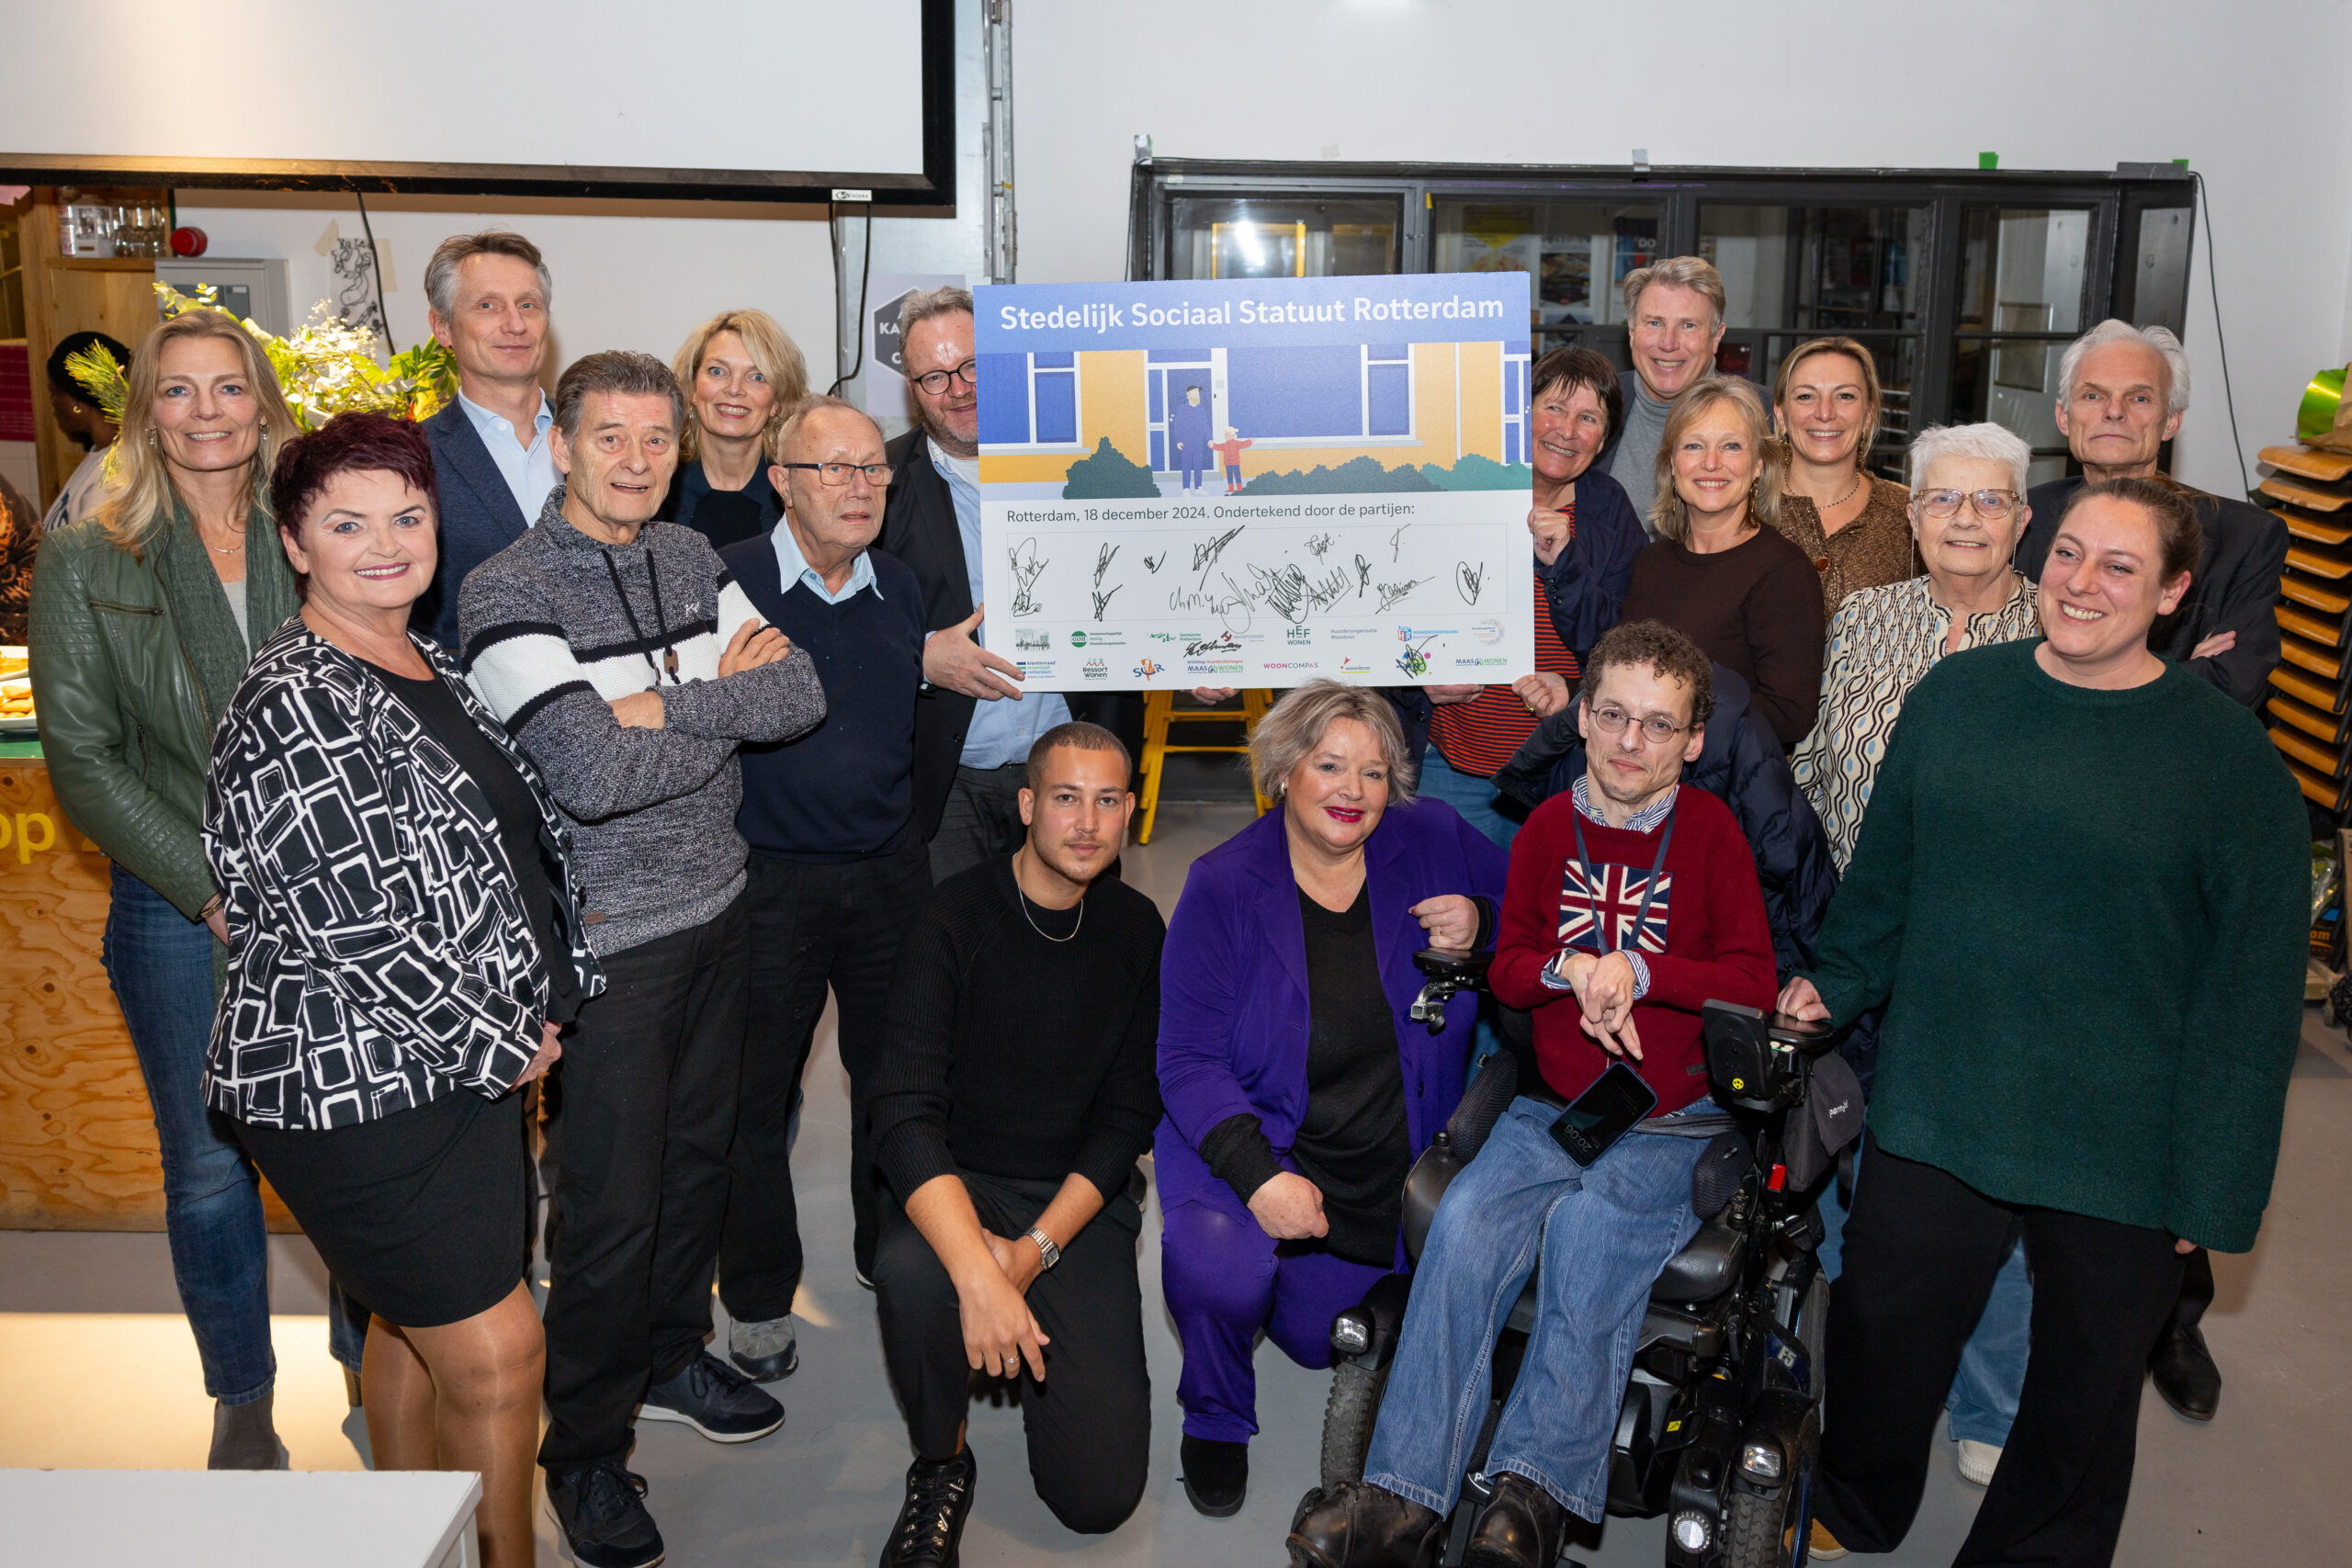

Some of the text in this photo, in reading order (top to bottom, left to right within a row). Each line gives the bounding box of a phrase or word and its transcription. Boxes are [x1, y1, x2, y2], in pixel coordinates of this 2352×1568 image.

[1000, 294, 1504, 334] Stedelijk Sociaal Statuut Rotterdam
[1007, 502, 1416, 523] Rotterdam, 18 december 2024. Ondertekend door de partijen:
[1286, 625, 1311, 638] HEF
[1262, 661, 1319, 670] WOONCOMPAS
[1564, 1123, 1593, 1153] 20:06
